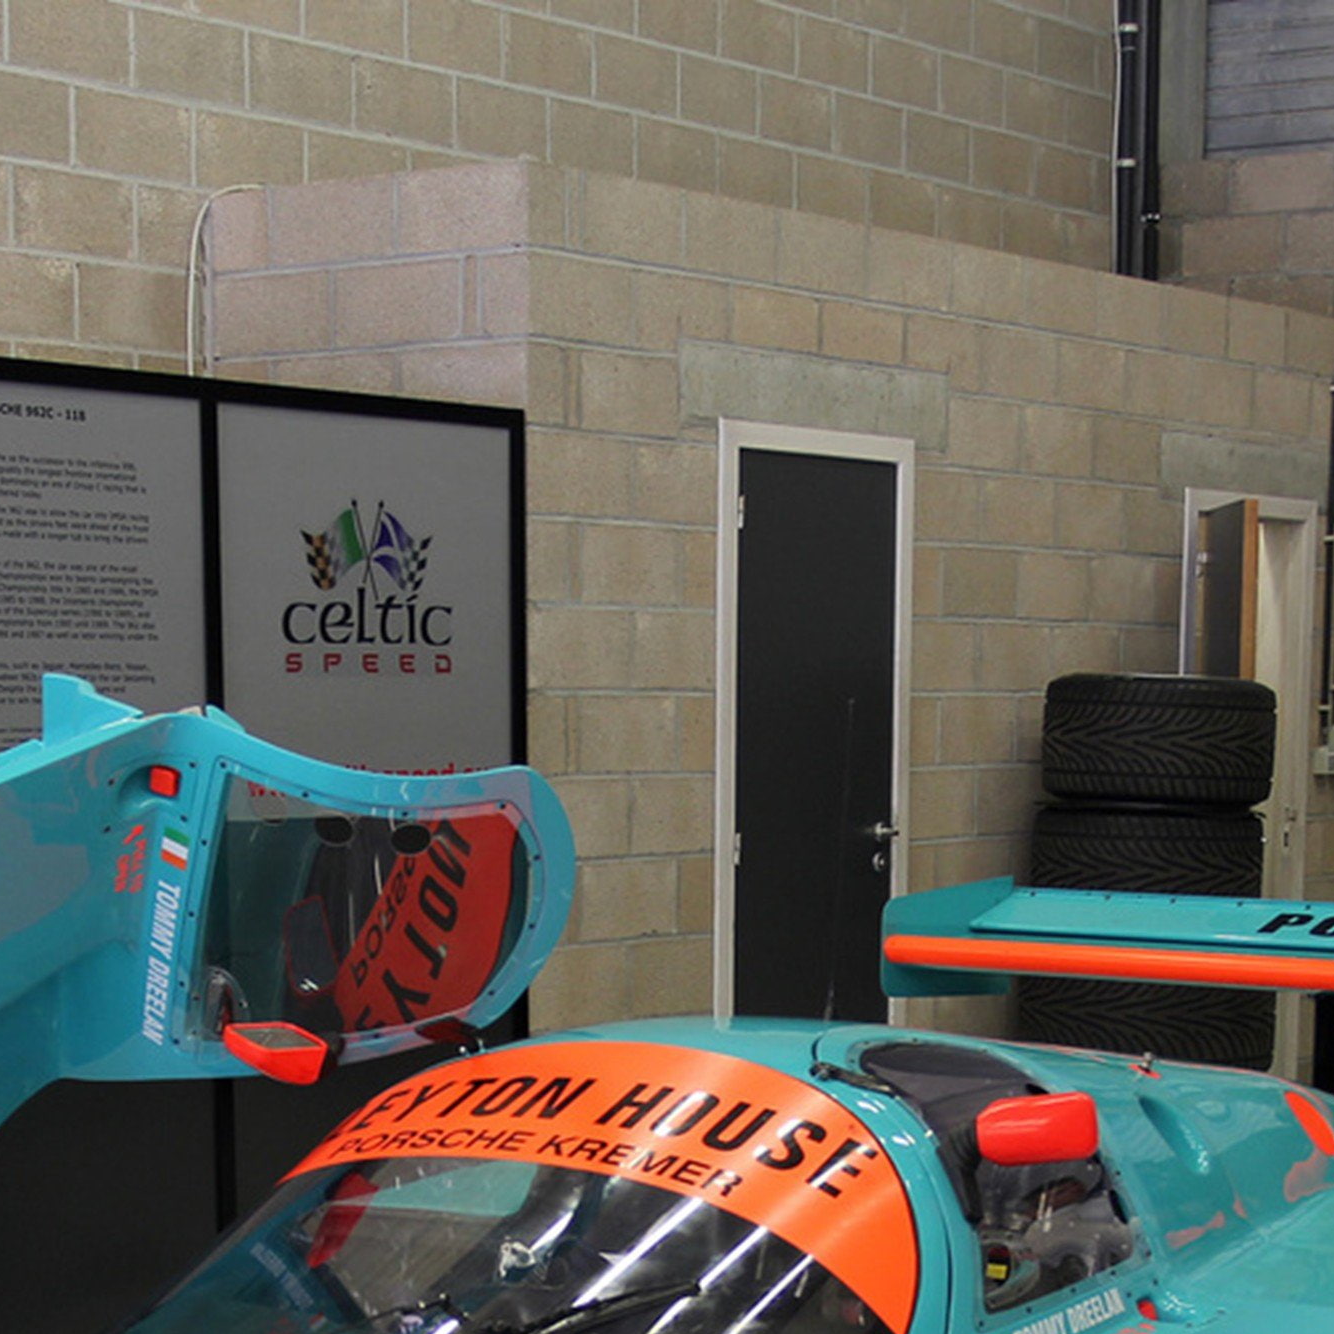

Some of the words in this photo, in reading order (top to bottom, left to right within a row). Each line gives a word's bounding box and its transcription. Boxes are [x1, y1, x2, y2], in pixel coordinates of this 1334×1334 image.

[281, 587, 454, 646] celtic
[285, 653, 452, 673] SPEED
[151, 880, 181, 960] TOMMY
[142, 956, 171, 1046] DREELAN
[328, 1127, 525, 1159] PORSCHE
[537, 1134, 744, 1198] KREMER
[596, 1083, 878, 1199] HOUSE
[1066, 1288, 1126, 1334] DREELAN
